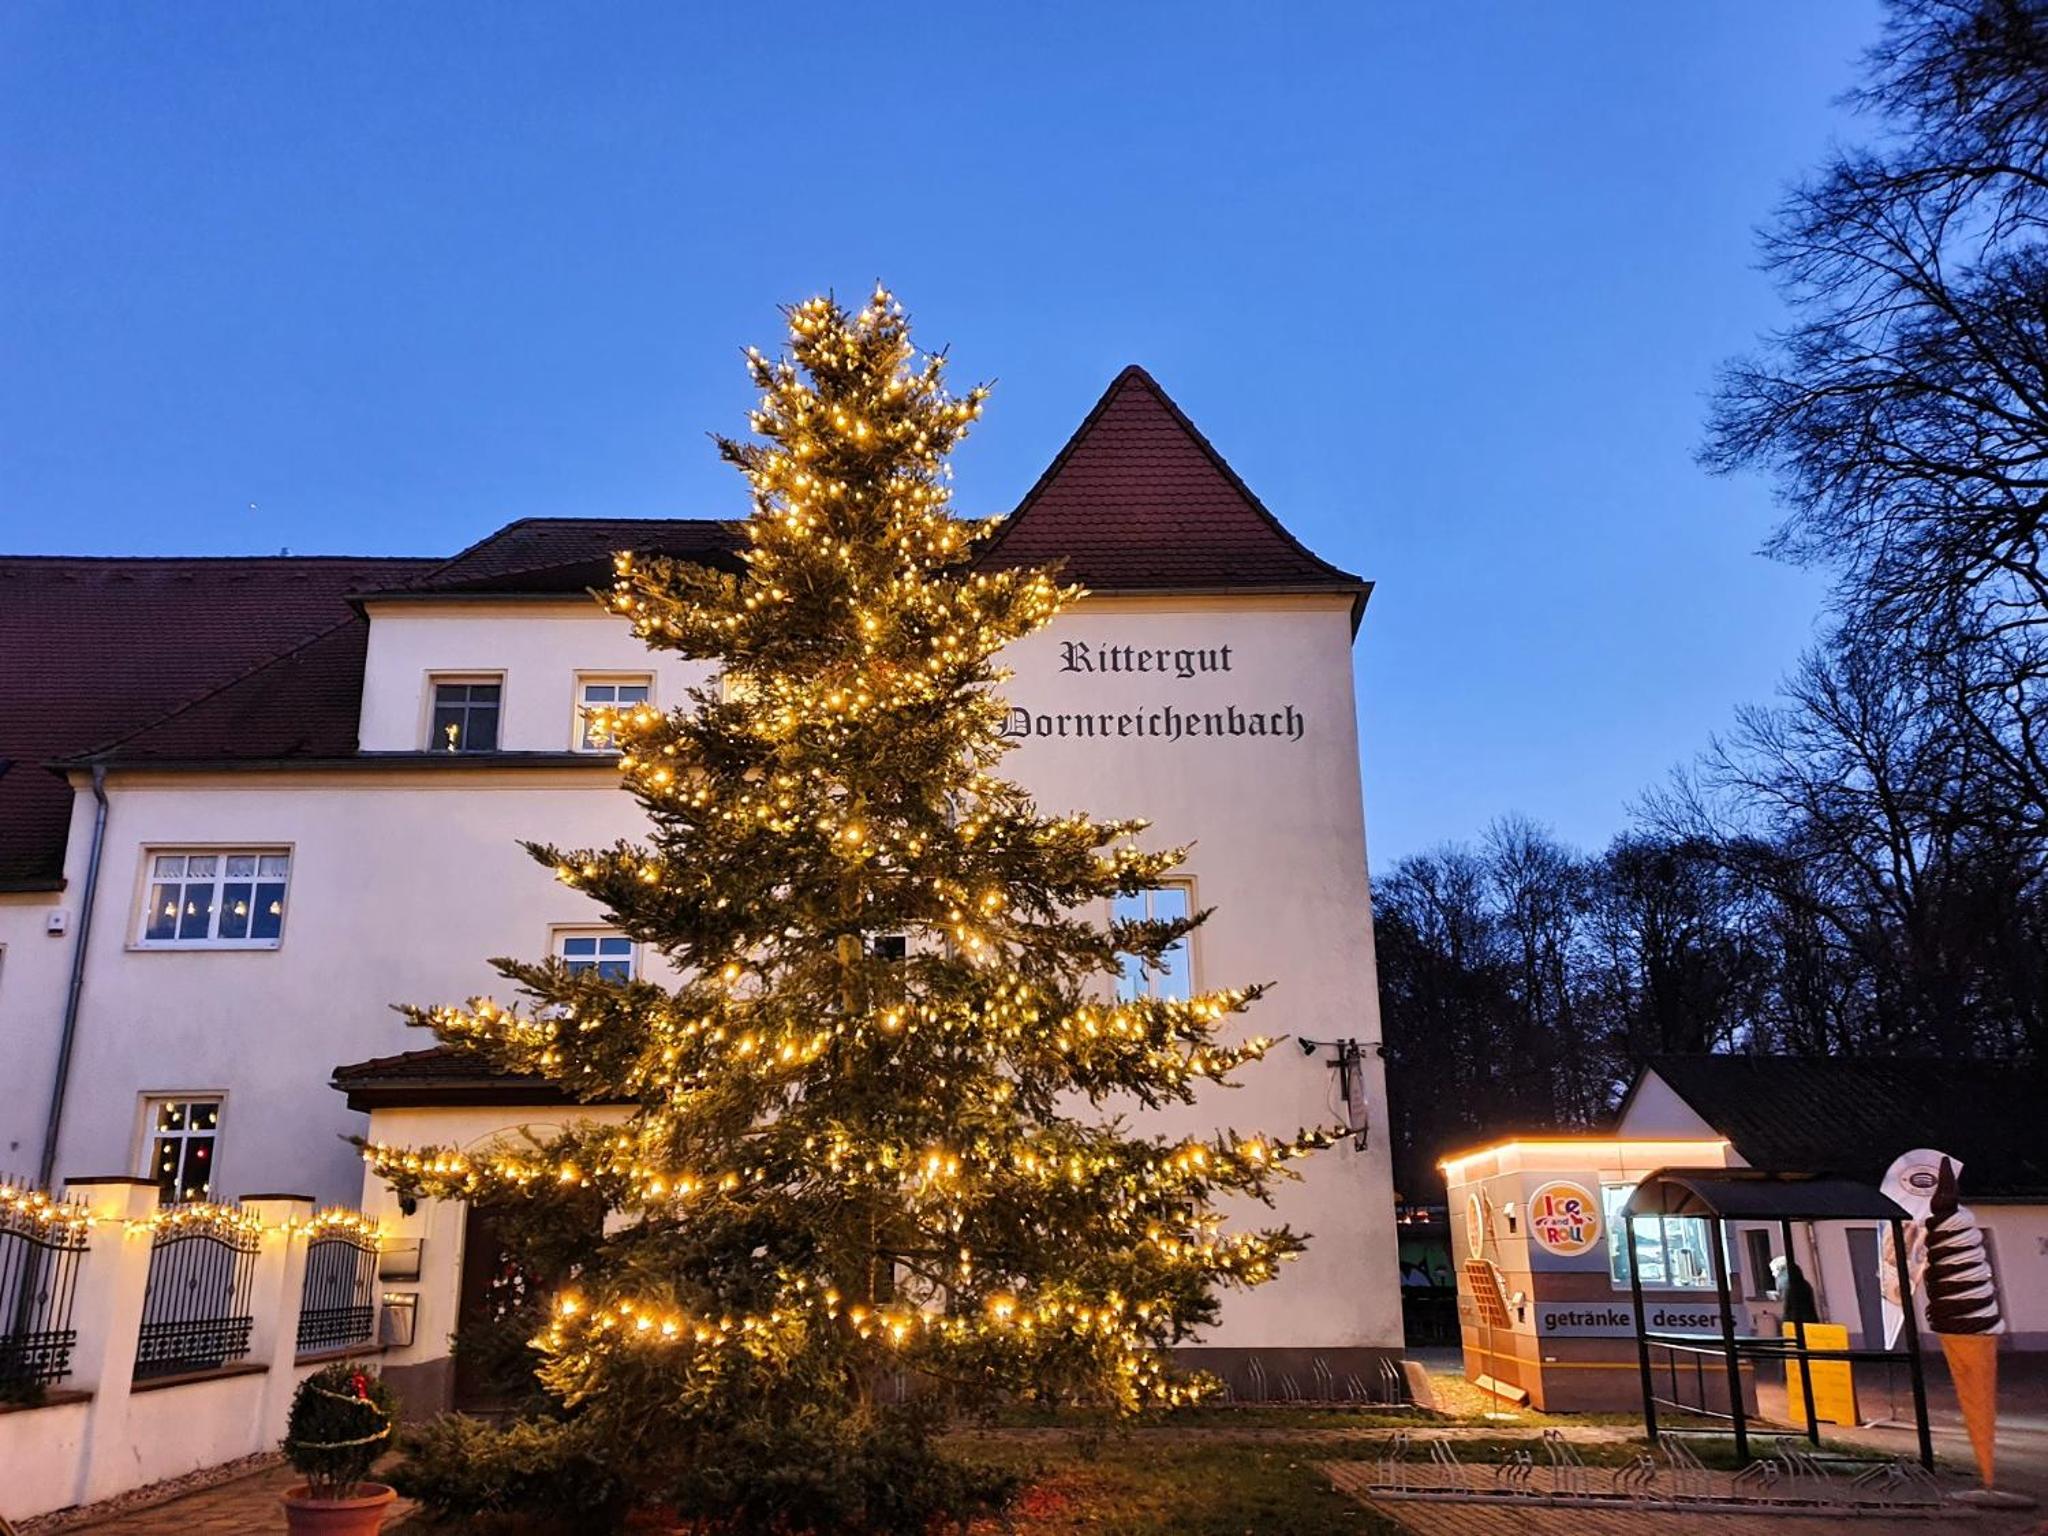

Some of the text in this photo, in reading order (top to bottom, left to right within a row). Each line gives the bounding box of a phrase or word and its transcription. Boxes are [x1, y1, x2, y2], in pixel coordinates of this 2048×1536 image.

[1059, 641, 1232, 678] Rittergut
[1000, 704, 1305, 742] Dornreichenbach
[1545, 1309, 1737, 1330] getränke dessers
